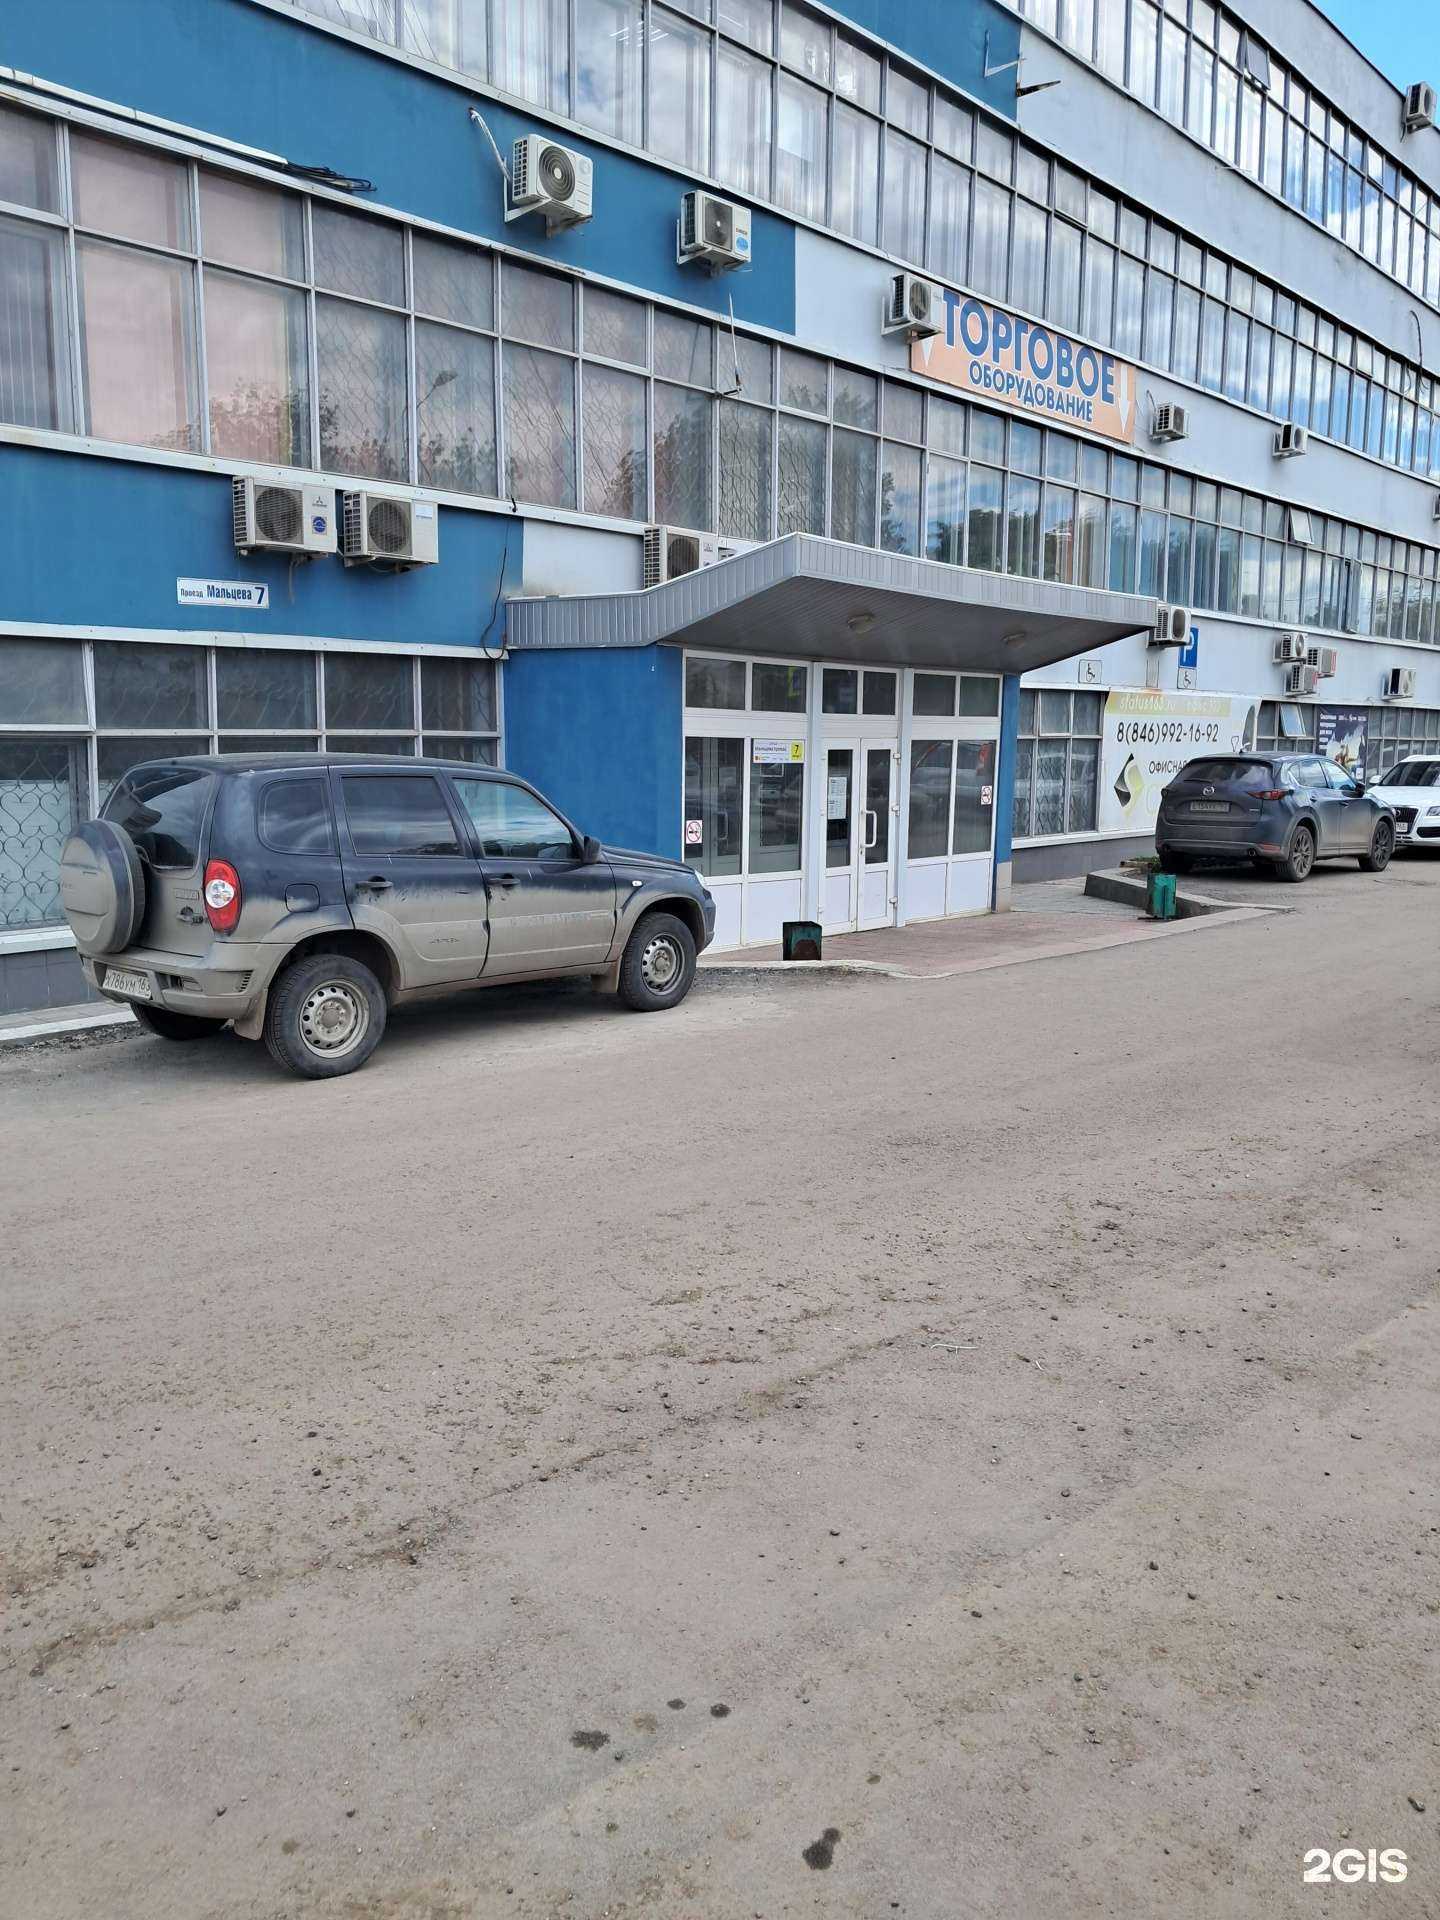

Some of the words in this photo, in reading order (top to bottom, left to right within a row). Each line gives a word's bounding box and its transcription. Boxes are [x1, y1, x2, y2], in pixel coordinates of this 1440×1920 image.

[943, 289, 1116, 405] ТОРГОВОЕ
[969, 359, 1094, 423] ОБОРУДОВАНИЕ
[180, 588, 204, 598] Проезд
[206, 584, 252, 600] Мальцева
[254, 586, 265, 605] 7
[1116, 721, 1219, 746] 8(846)992-16-92
